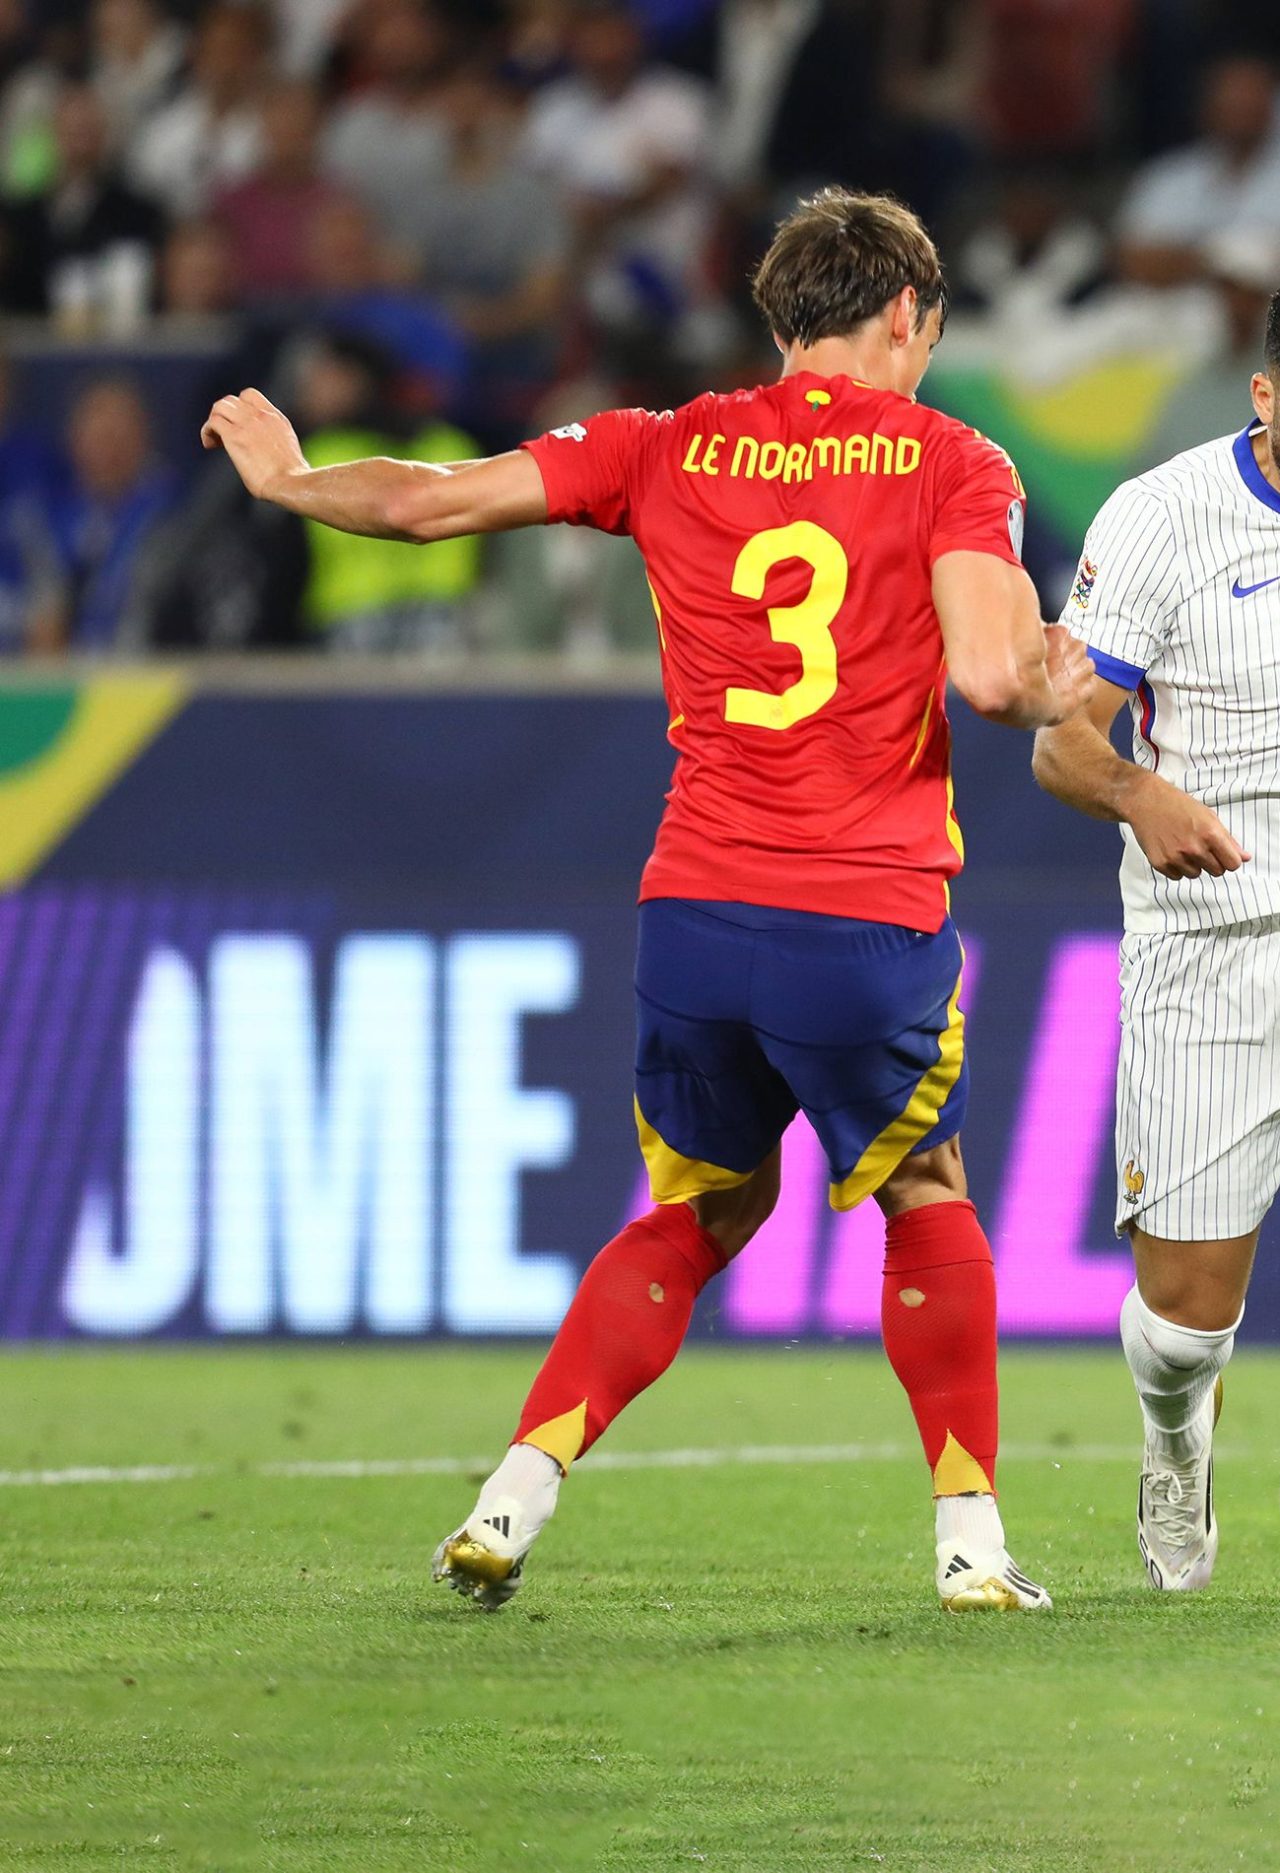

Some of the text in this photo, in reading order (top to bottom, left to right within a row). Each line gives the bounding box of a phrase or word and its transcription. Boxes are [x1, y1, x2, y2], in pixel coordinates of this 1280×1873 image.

[682, 432, 922, 484] LE NORMAND
[724, 519, 849, 731] 3
